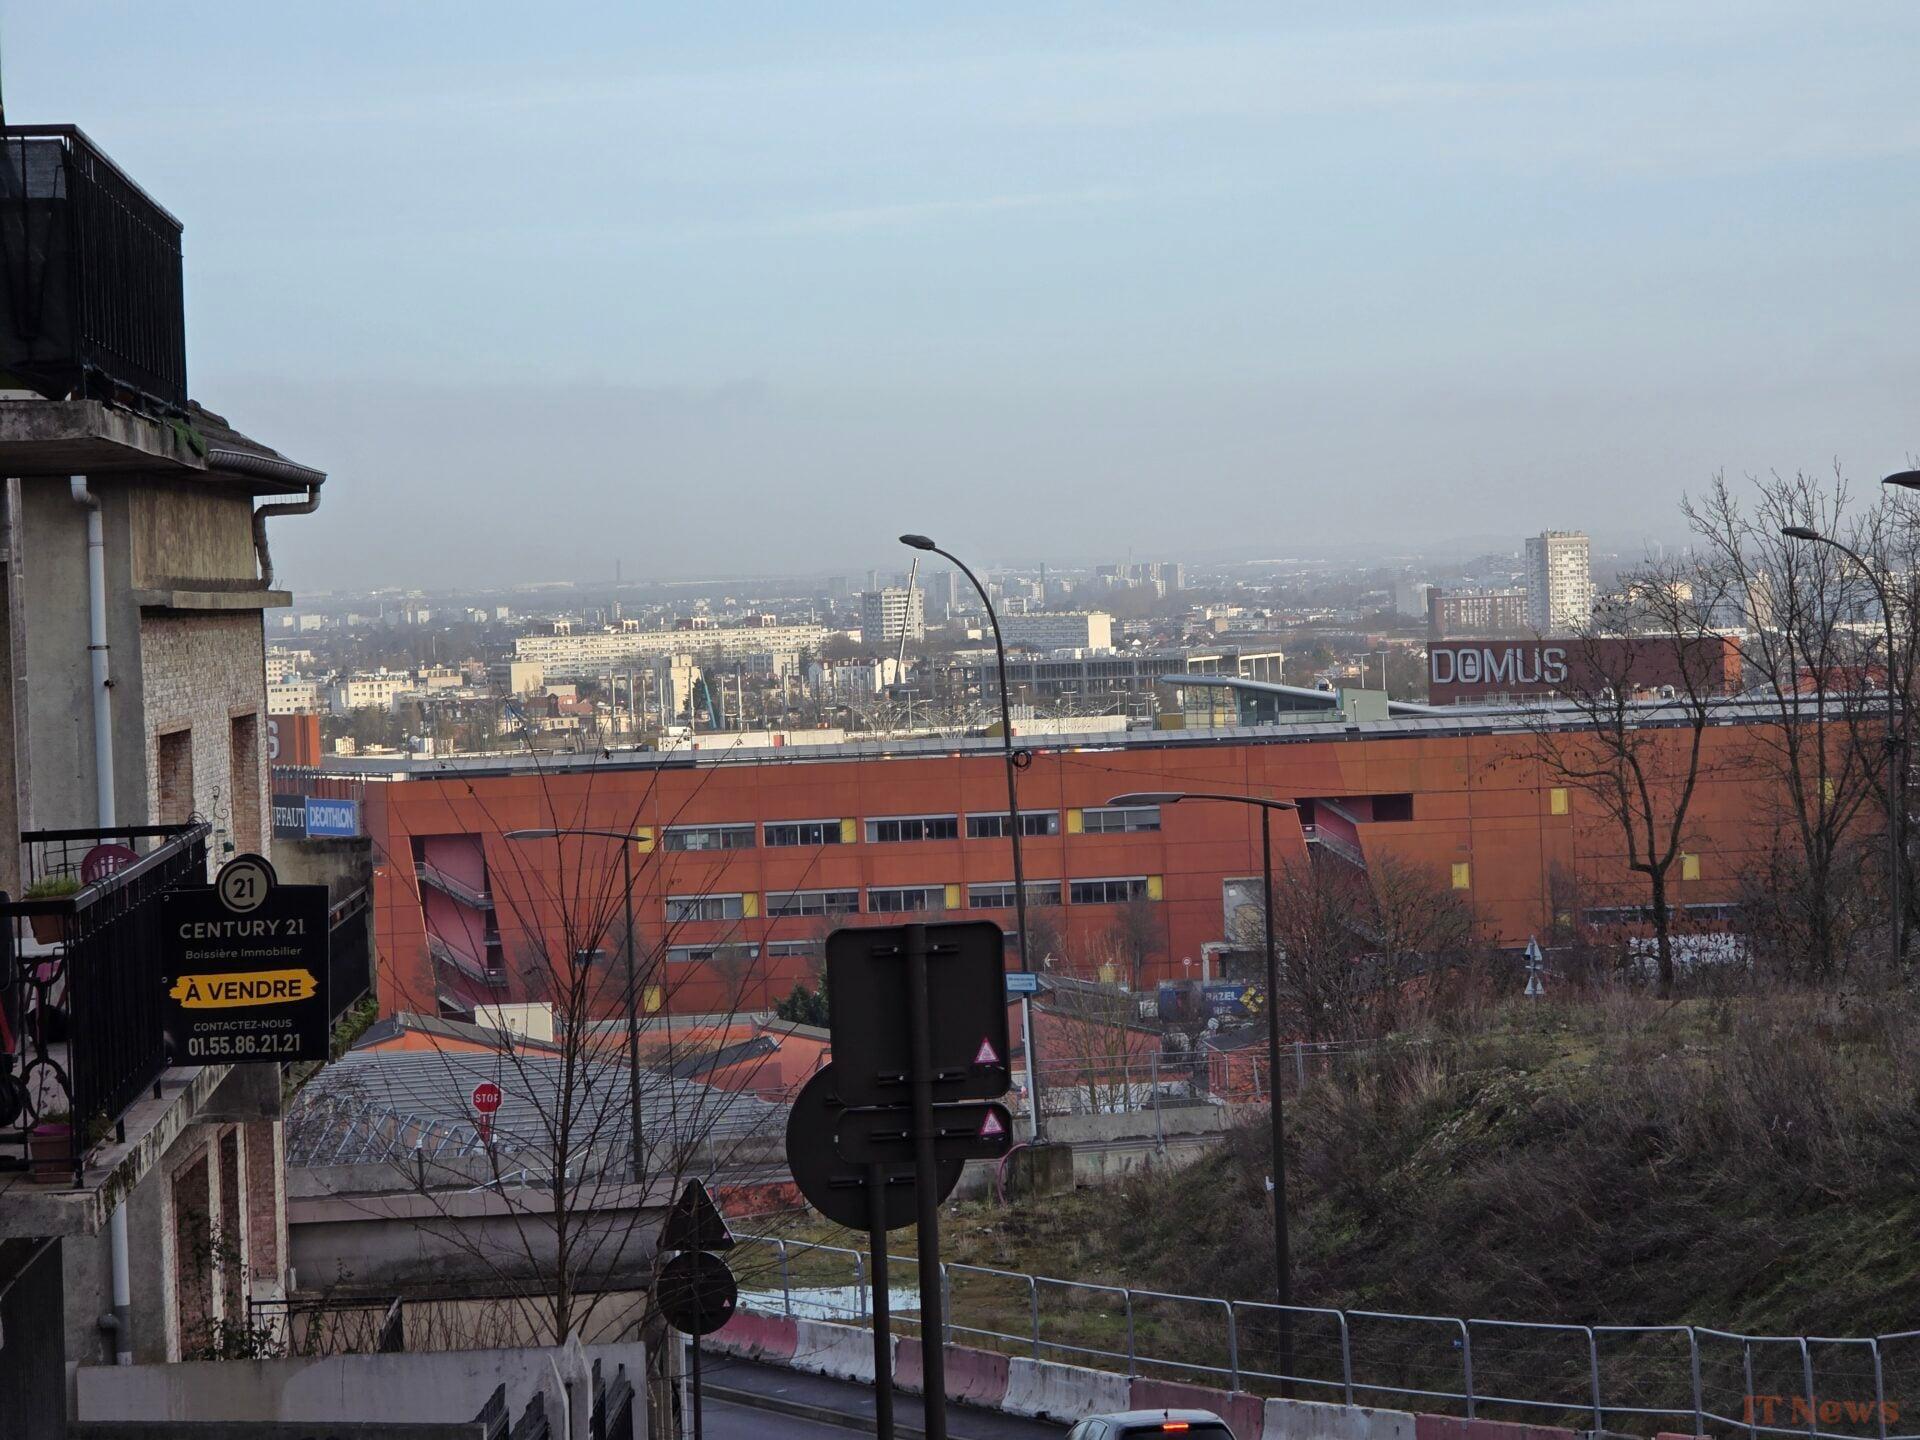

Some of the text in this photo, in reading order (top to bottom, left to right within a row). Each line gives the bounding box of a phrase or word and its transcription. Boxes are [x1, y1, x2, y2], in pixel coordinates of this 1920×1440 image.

[1432, 648, 1568, 684] DOMUS
[309, 806, 353, 828] DECATHLON
[233, 878, 254, 898] 21
[179, 918, 305, 939] CENTURY 21
[185, 947, 302, 960] Boissière Immobilier
[185, 978, 302, 1002] À VENDRE
[193, 1018, 293, 1032] CONTACTEZ-NOUS
[188, 1033, 301, 1056] 01.55.86.21.21
